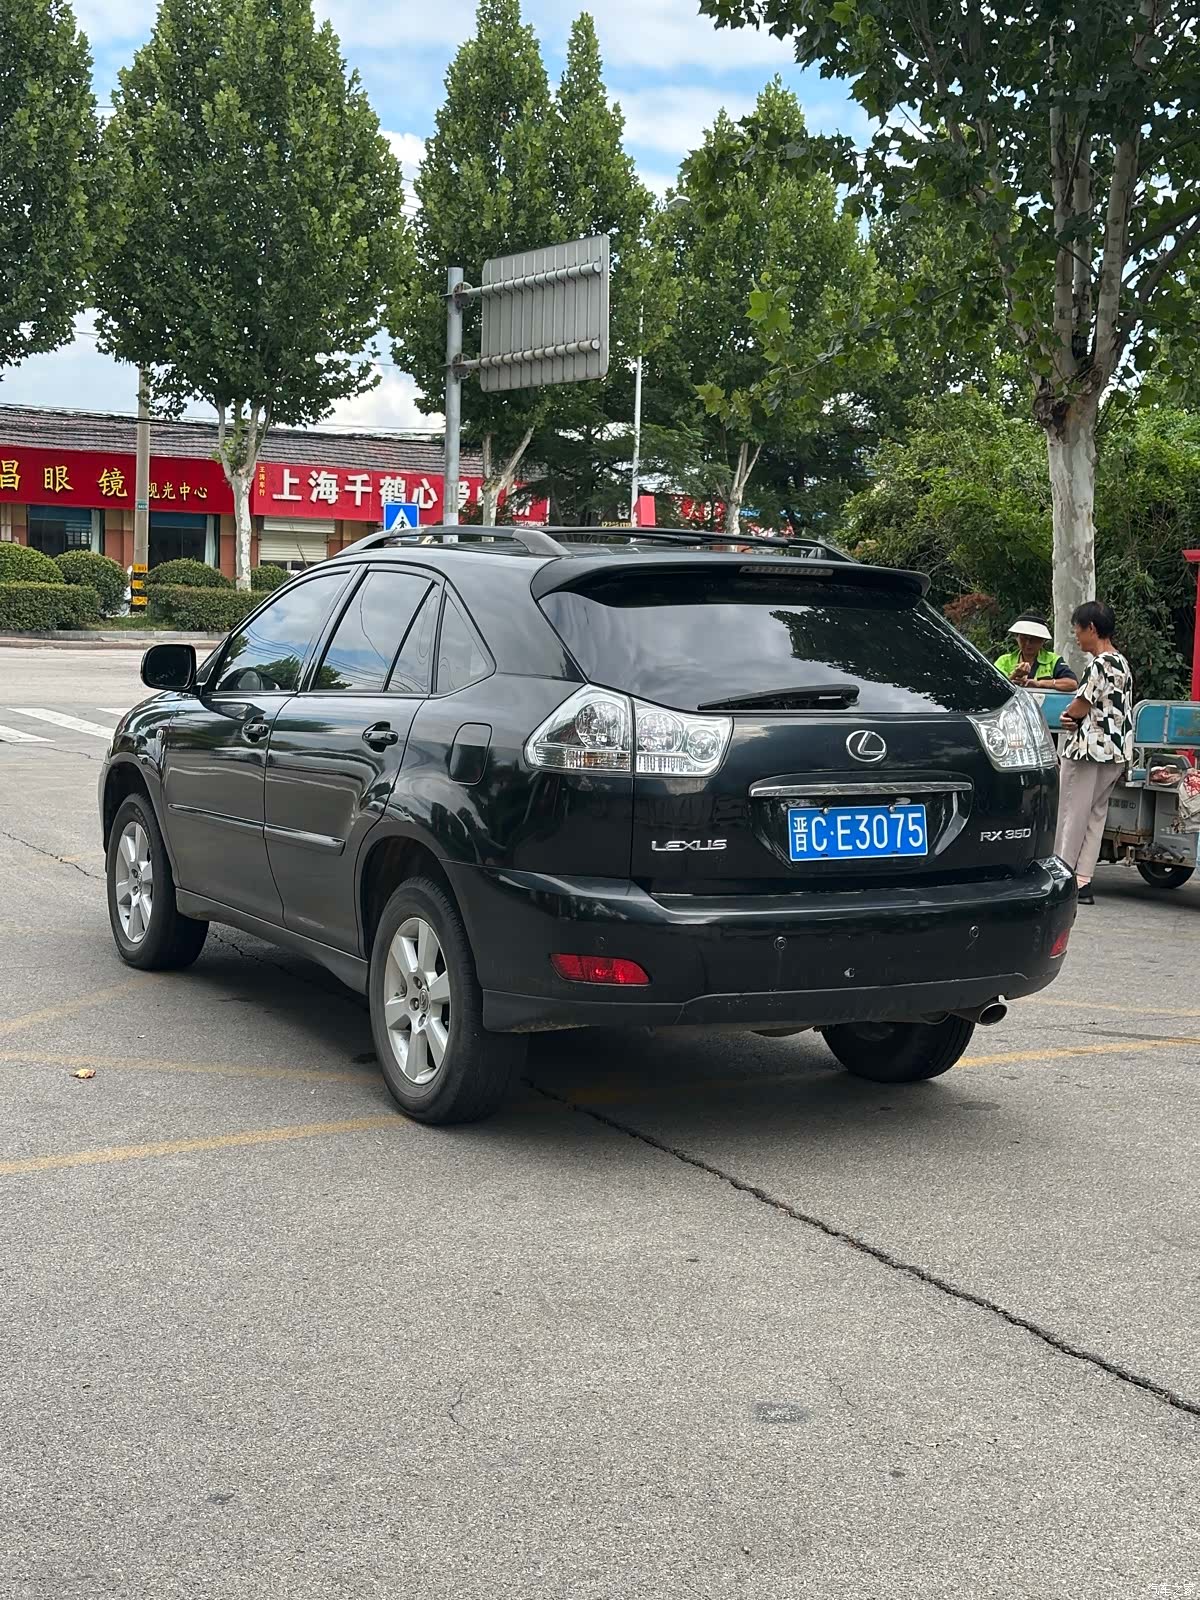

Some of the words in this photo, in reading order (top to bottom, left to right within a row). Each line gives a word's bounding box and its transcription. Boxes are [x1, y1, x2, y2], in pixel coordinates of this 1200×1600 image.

[0, 459, 128, 498] 昌眼镜
[980, 830, 1003, 842] RX
[1004, 828, 1032, 840] 350
[651, 839, 728, 852] LEXUS
